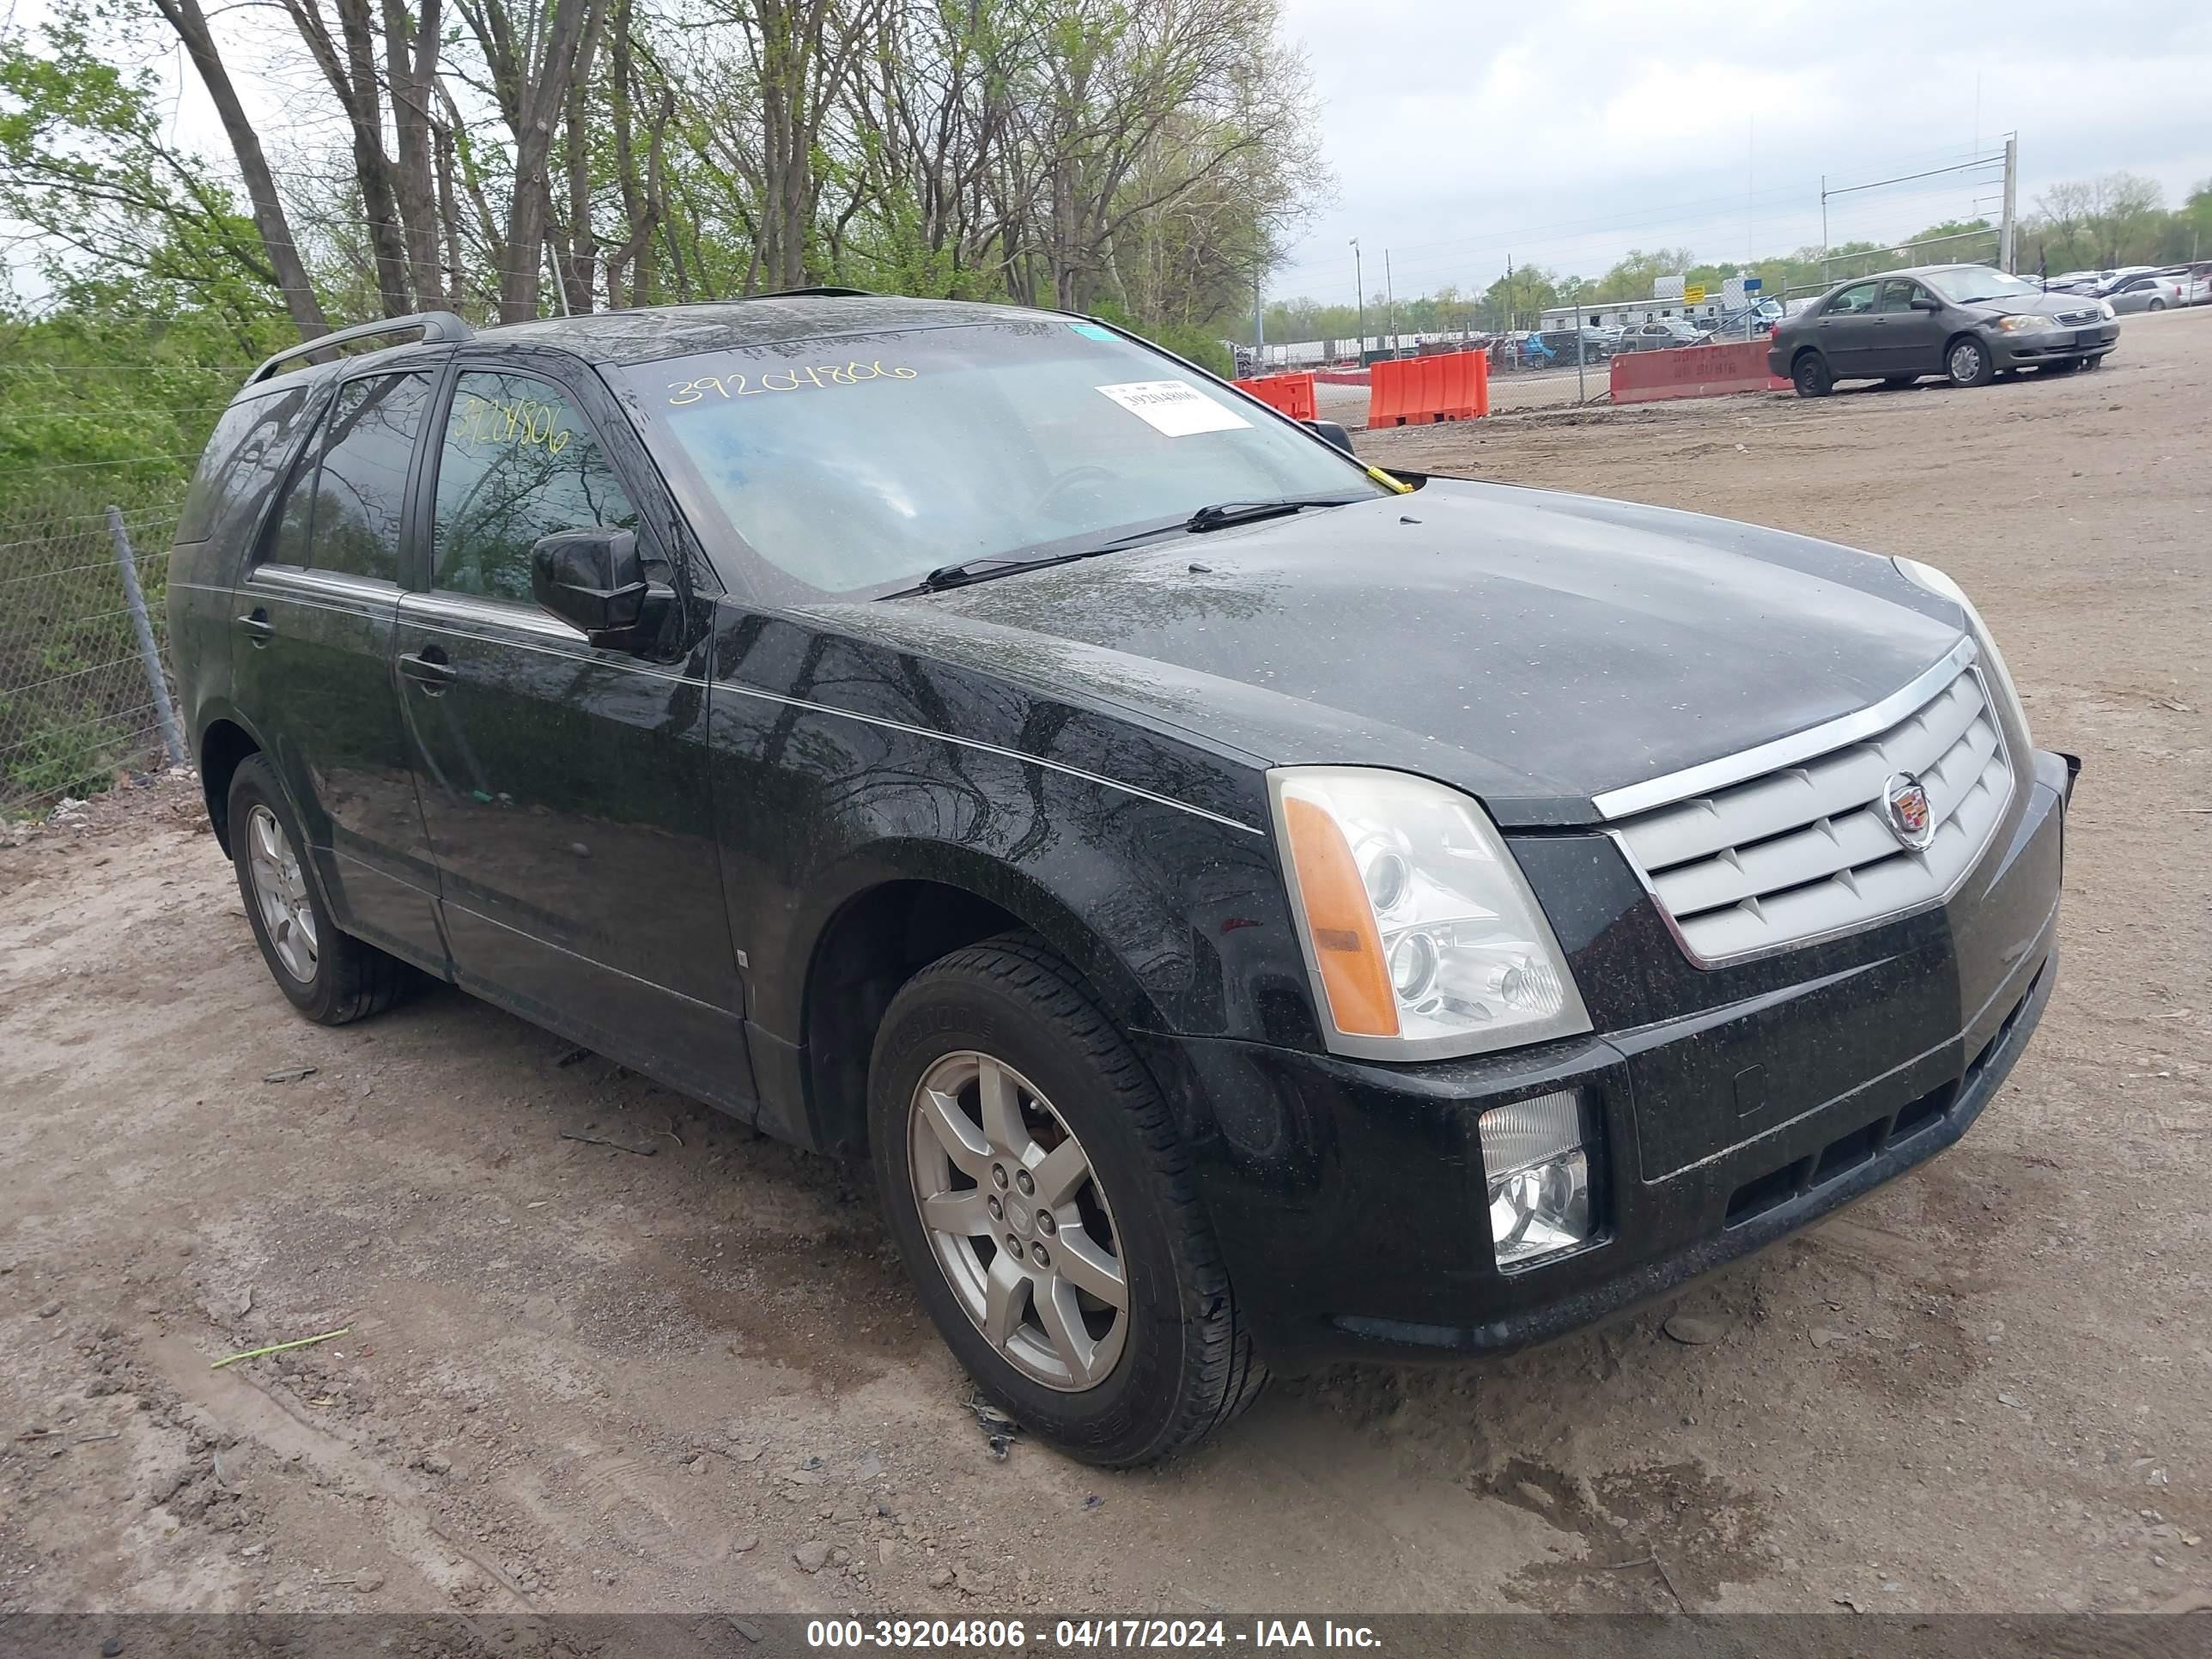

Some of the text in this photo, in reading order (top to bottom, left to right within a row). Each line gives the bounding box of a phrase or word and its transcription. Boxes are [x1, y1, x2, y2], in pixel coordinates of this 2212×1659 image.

[666, 360, 919, 405] 39204806
[1123, 391, 1199, 406] 39204806
[453, 396, 569, 454] 39204806
